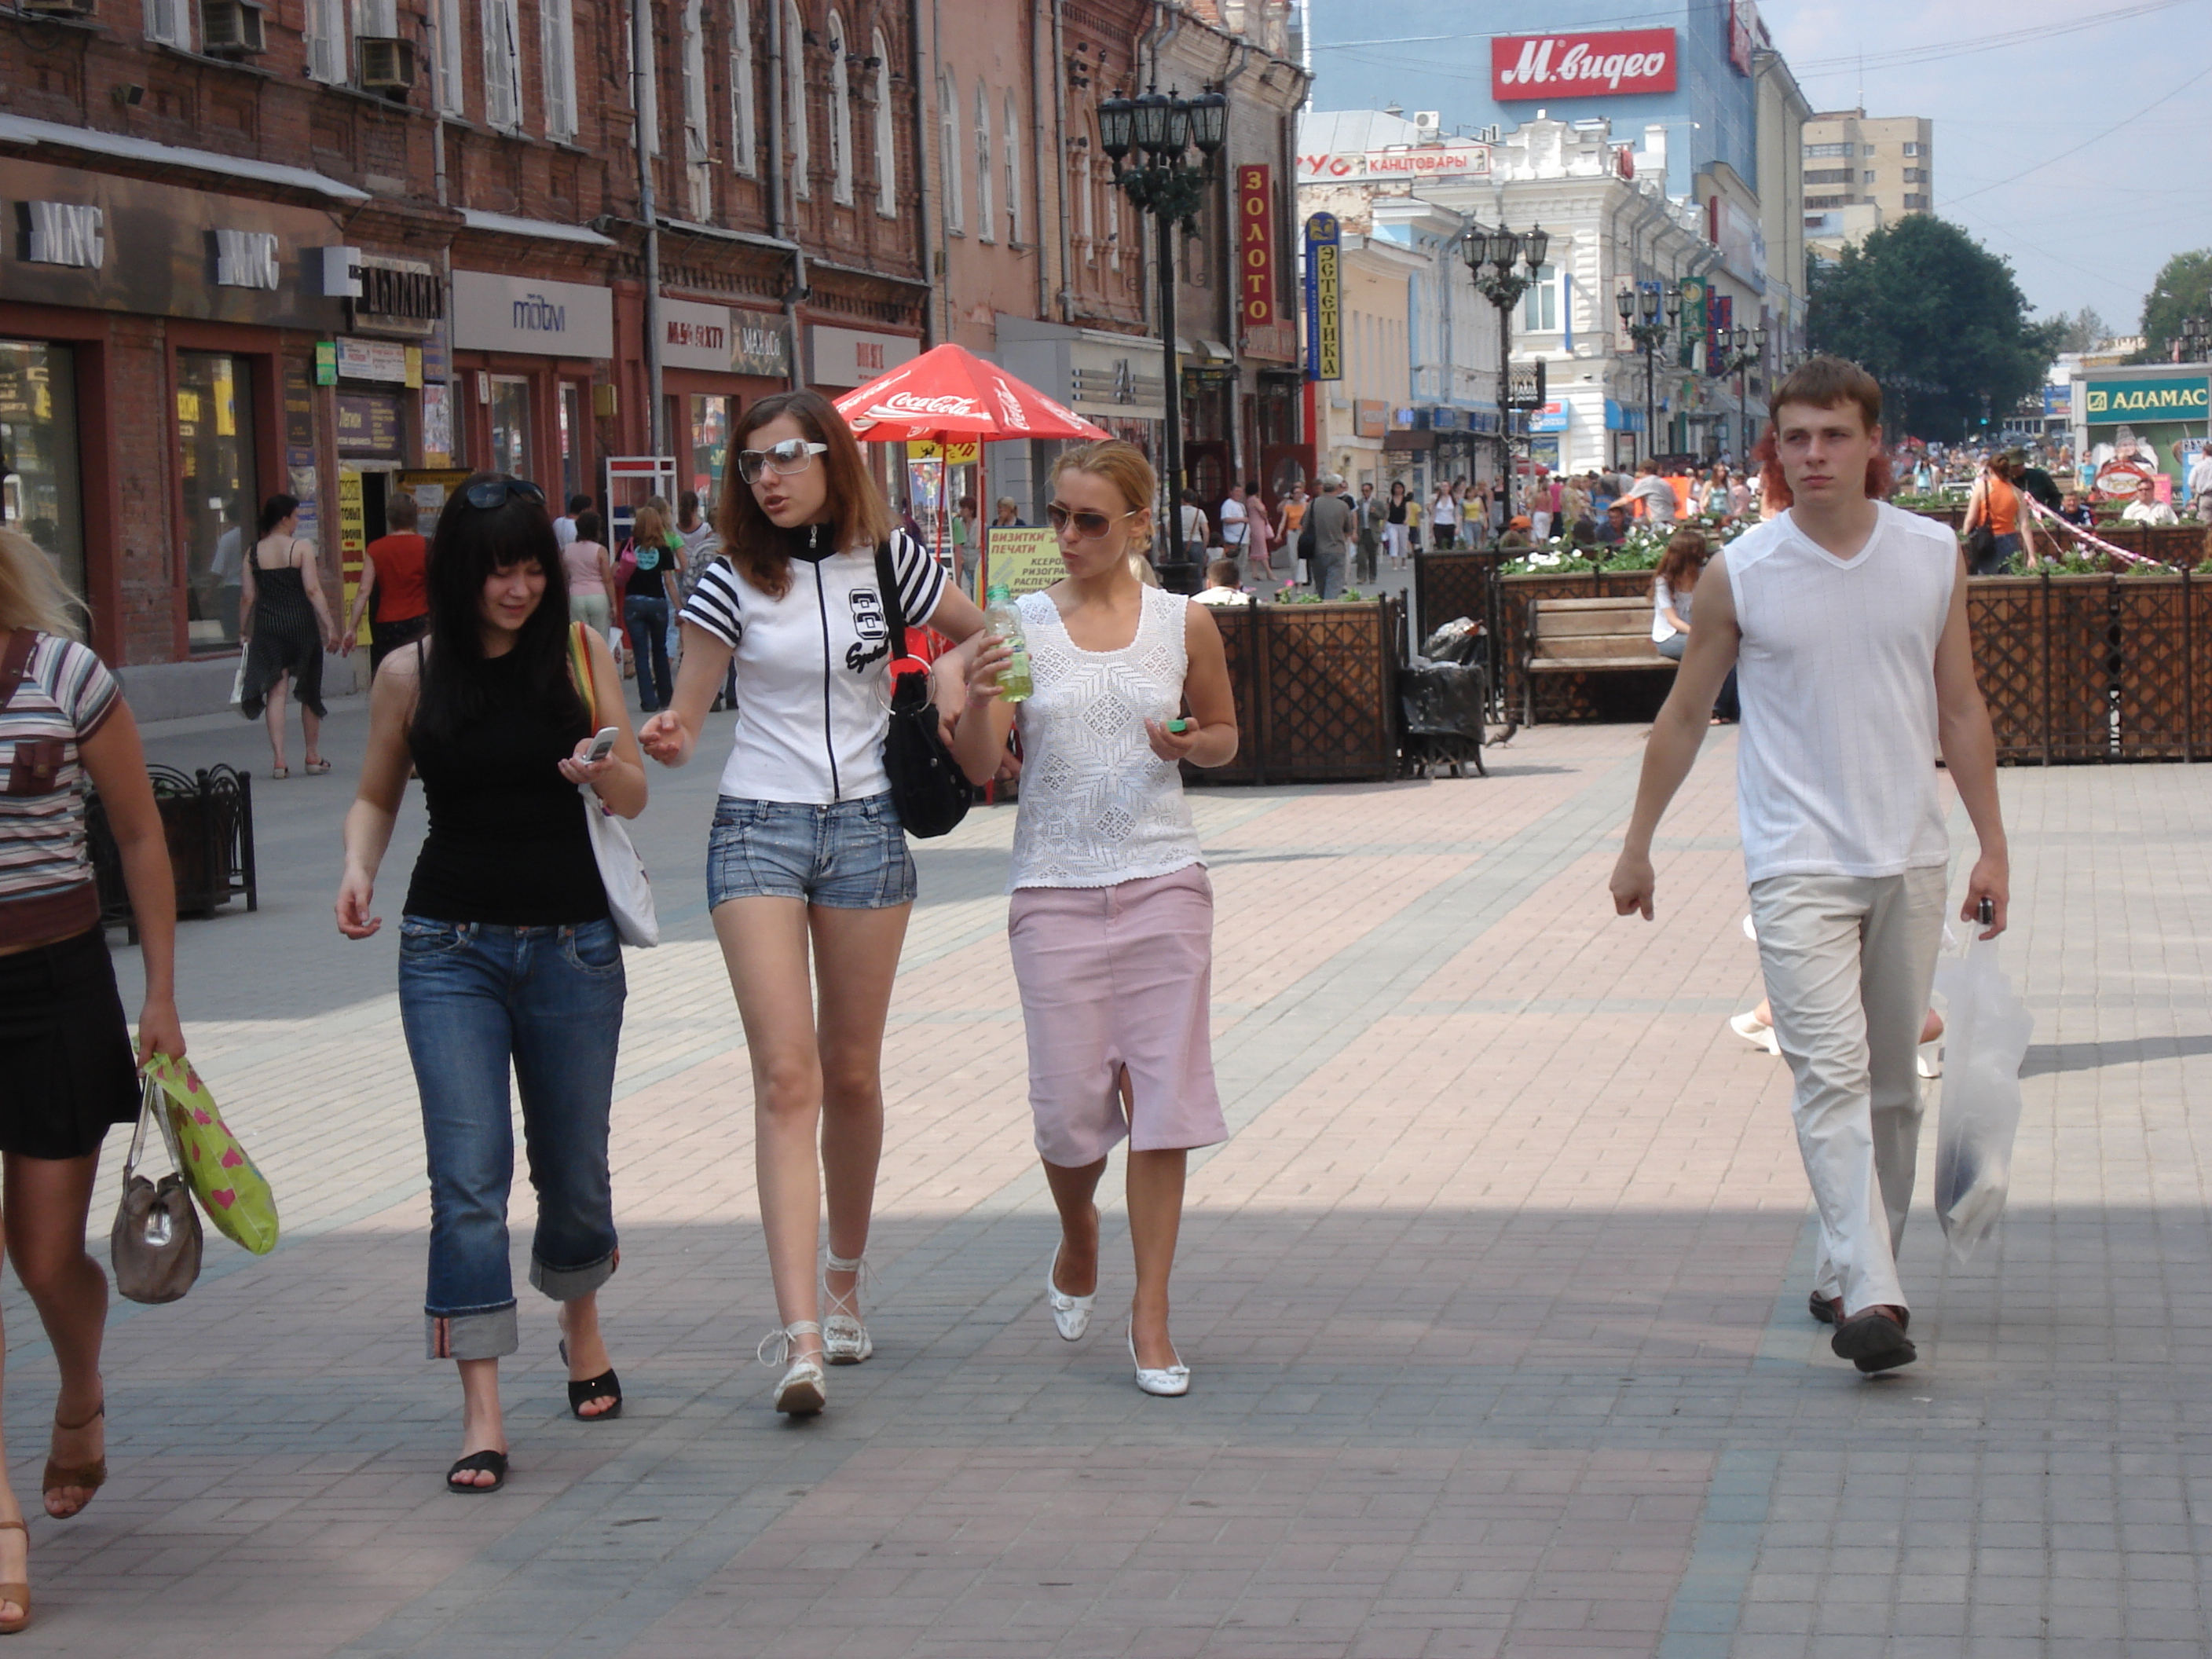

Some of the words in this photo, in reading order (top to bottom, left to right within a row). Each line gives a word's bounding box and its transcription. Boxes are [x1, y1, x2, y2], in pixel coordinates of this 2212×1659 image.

[1500, 39, 1665, 90] М.видео
[1369, 156, 1467, 172] КАНЦТОВАРЫ
[1245, 171, 1267, 319] ЗОЛОТО
[1321, 246, 1336, 375] ЭСТЕТИКА
[886, 391, 979, 416] Coca-Cola
[2112, 388, 2208, 410] АДАМАС
[991, 533, 1045, 542] ВИЗИТКИ
[991, 544, 1036, 553] ПЕЧАТИ
